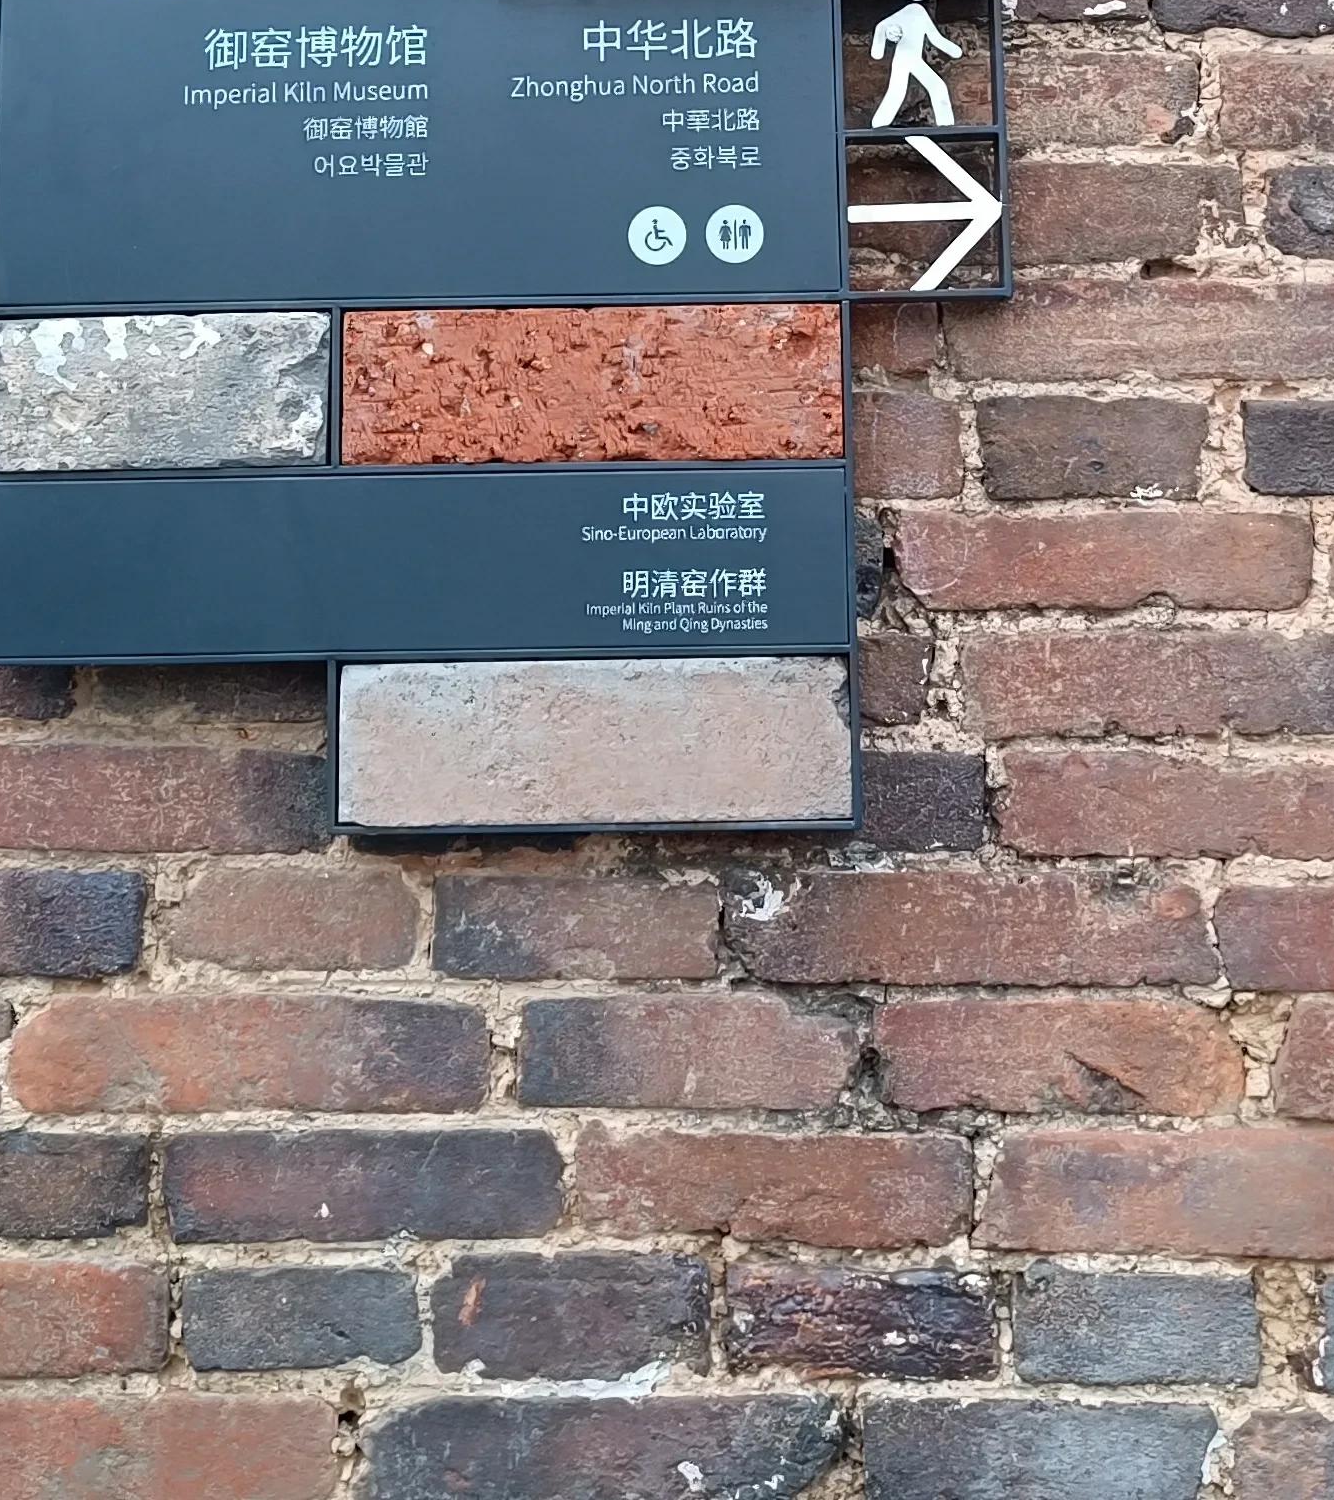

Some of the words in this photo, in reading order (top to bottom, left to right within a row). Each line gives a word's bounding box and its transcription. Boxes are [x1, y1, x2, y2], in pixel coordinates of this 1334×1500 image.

[205, 25, 427, 70] 御窑博物馆
[584, 18, 757, 61] 中华北路
[185, 82, 276, 109] Imperial
[285, 81, 325, 102] Kiln
[334, 82, 427, 101] Museum
[511, 75, 624, 101] Zhonghua
[633, 73, 695, 94] North
[704, 71, 758, 93] Road
[671, 146, 761, 170] 중화북로
[624, 491, 765, 521] 中欧实验室
[582, 526, 686, 543] Sino-European
[690, 524, 767, 542] Laboratory
[624, 568, 766, 598] 明清窑作群
[587, 602, 635, 617] Imperial
[639, 602, 660, 614] Kiln
[665, 602, 695, 616] Plant
[698, 602, 731, 613] Ruins
[733, 601, 745, 613] of
[748, 601, 767, 613] the
[623, 618, 652, 633] Ming
[652, 619, 676, 630] and
[680, 618, 708, 633] Qing
[711, 618, 768, 633] Dynasties
